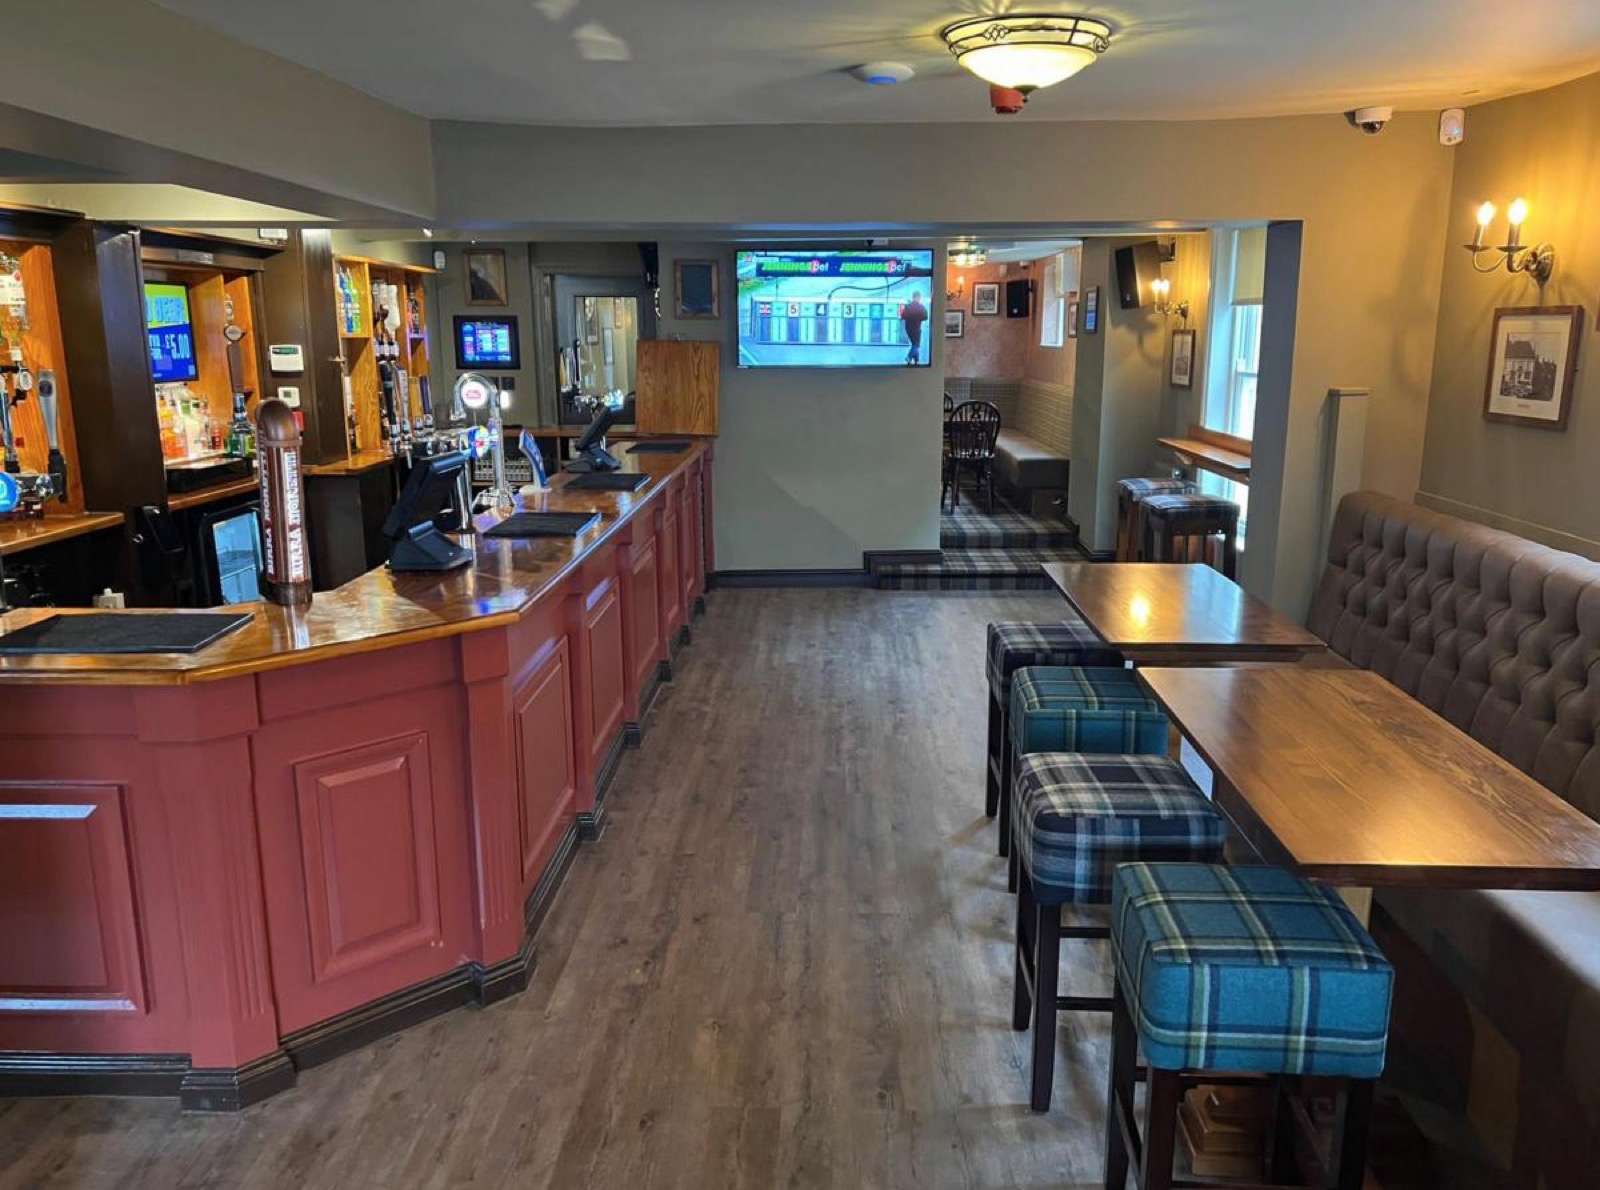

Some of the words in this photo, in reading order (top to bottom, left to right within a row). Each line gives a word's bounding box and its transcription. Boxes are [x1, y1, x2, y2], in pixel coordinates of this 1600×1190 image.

[790, 304, 797, 314] 5
[817, 304, 825, 315] 4
[844, 304, 853, 315] 3
